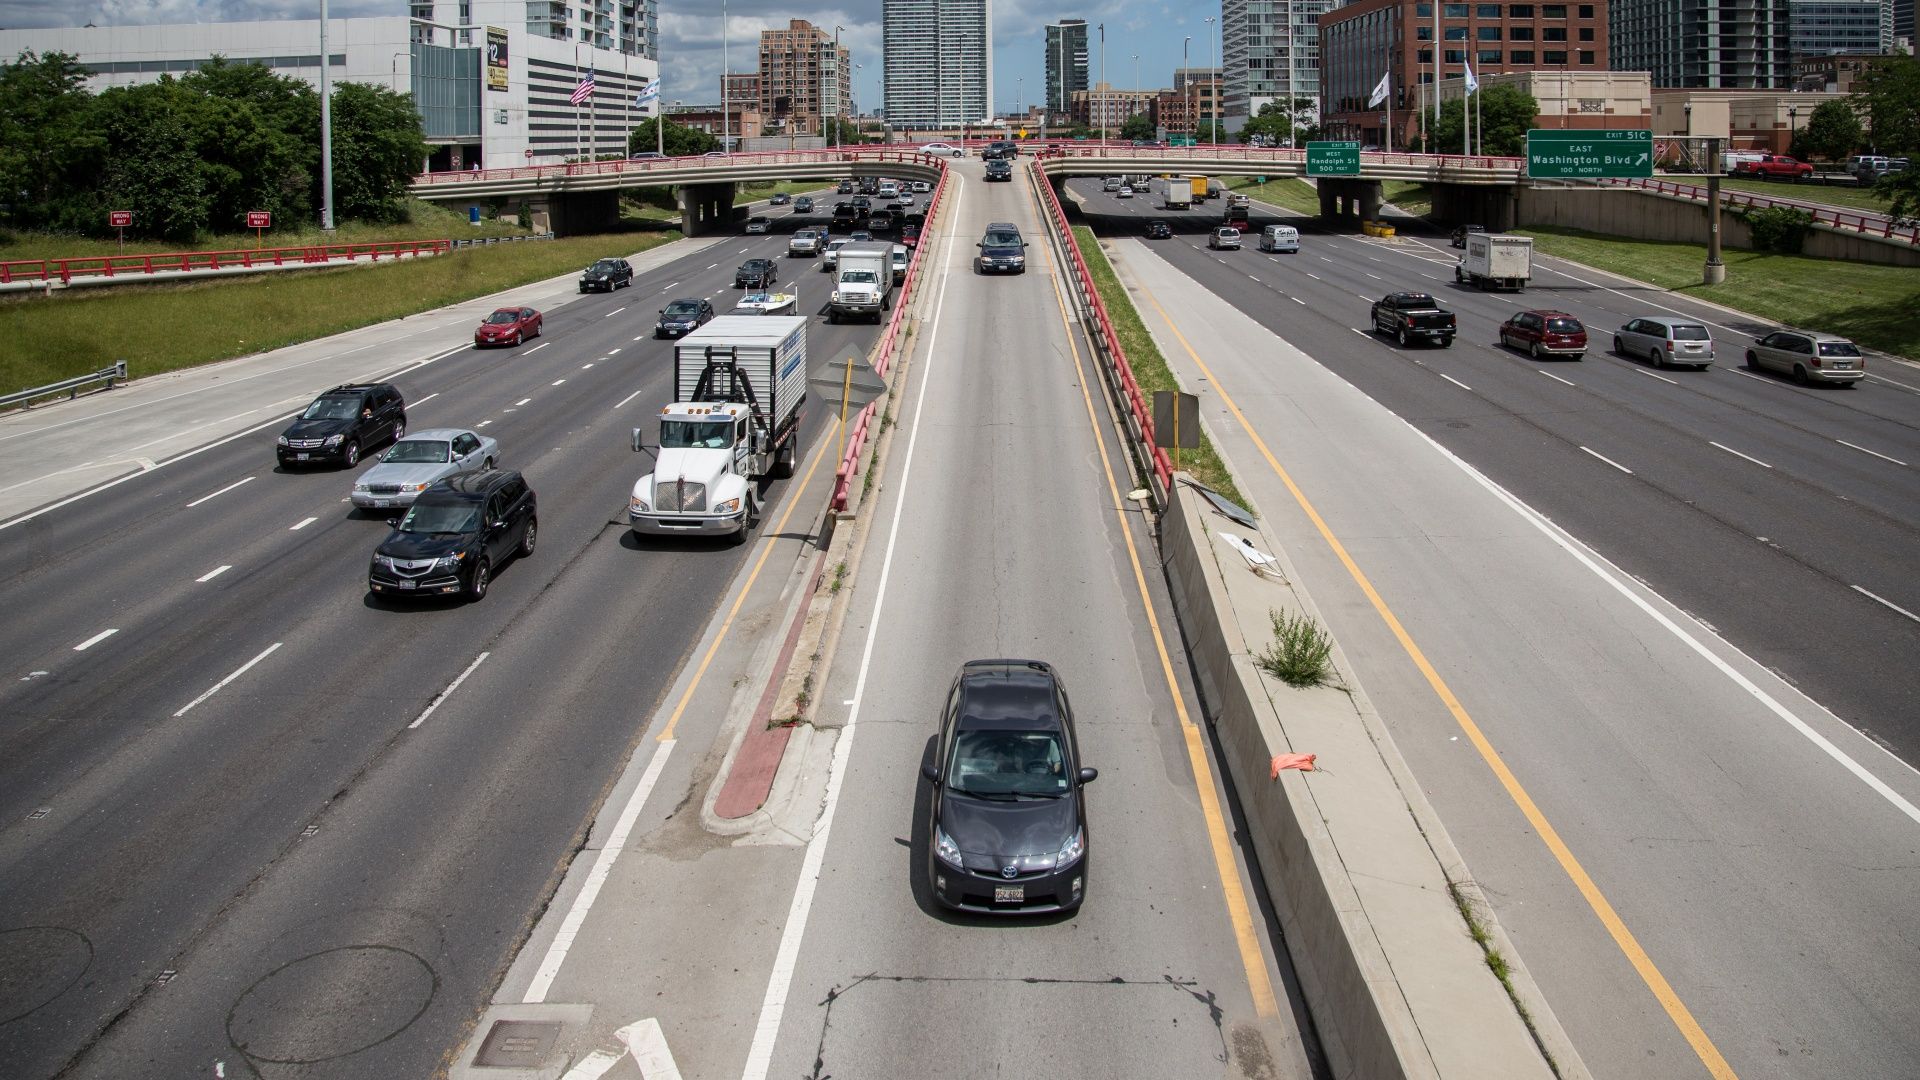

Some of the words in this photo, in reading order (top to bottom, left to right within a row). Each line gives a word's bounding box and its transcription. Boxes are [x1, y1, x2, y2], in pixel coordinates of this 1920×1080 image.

[1627, 131, 1646, 139] 51C
[1532, 155, 1599, 166] Washington
[1604, 155, 1631, 164] Blvd
